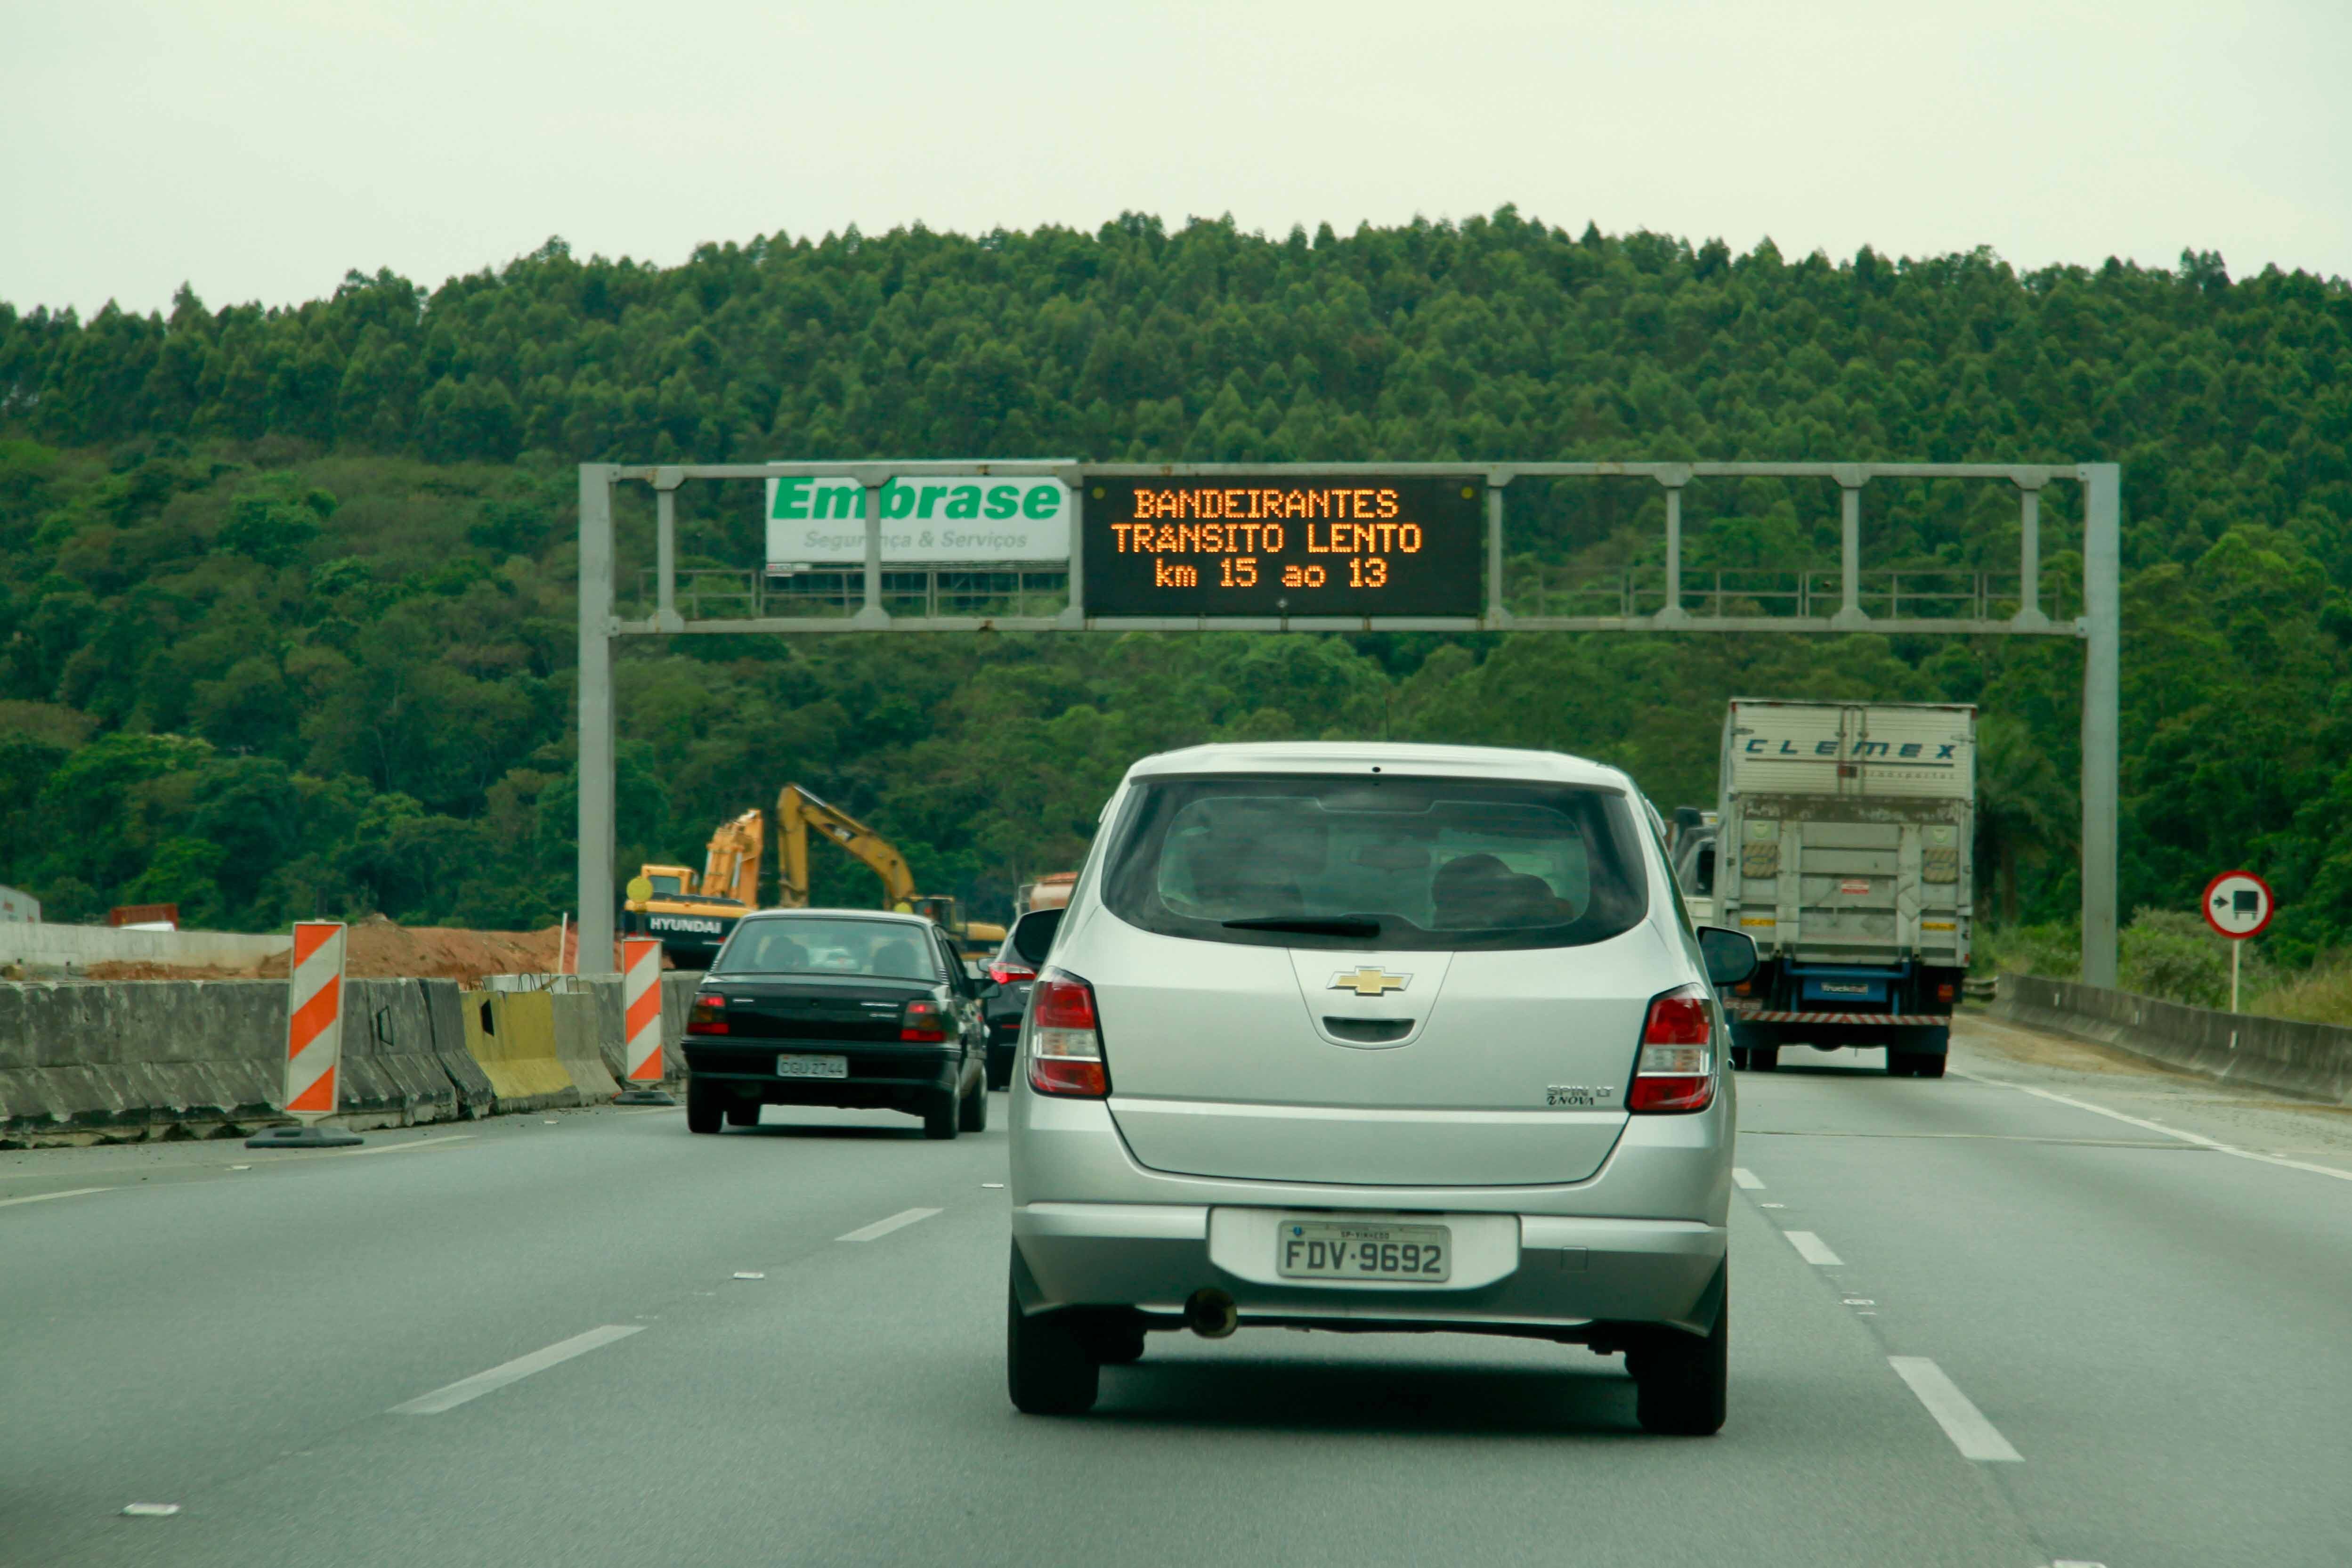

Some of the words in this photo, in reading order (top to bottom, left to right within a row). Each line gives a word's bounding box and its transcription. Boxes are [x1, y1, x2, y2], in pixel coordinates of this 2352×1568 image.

[771, 477, 1061, 520] Embrase
[1133, 488, 1400, 519] BANDEIRANTES
[803, 531, 912, 552] Segurnça
[917, 531, 935, 548] &
[940, 531, 1028, 552] Serviços
[1307, 522, 1422, 553] LENTO
[1155, 558, 1198, 587] km
[1220, 557, 1258, 587] 15
[1281, 564, 1327, 587] ao
[1348, 557, 1388, 587] 13
[650, 918, 722, 934] HYUNDAI
[1546, 1085, 1590, 1097] SPIN
[1596, 1086, 1615, 1098] LT
